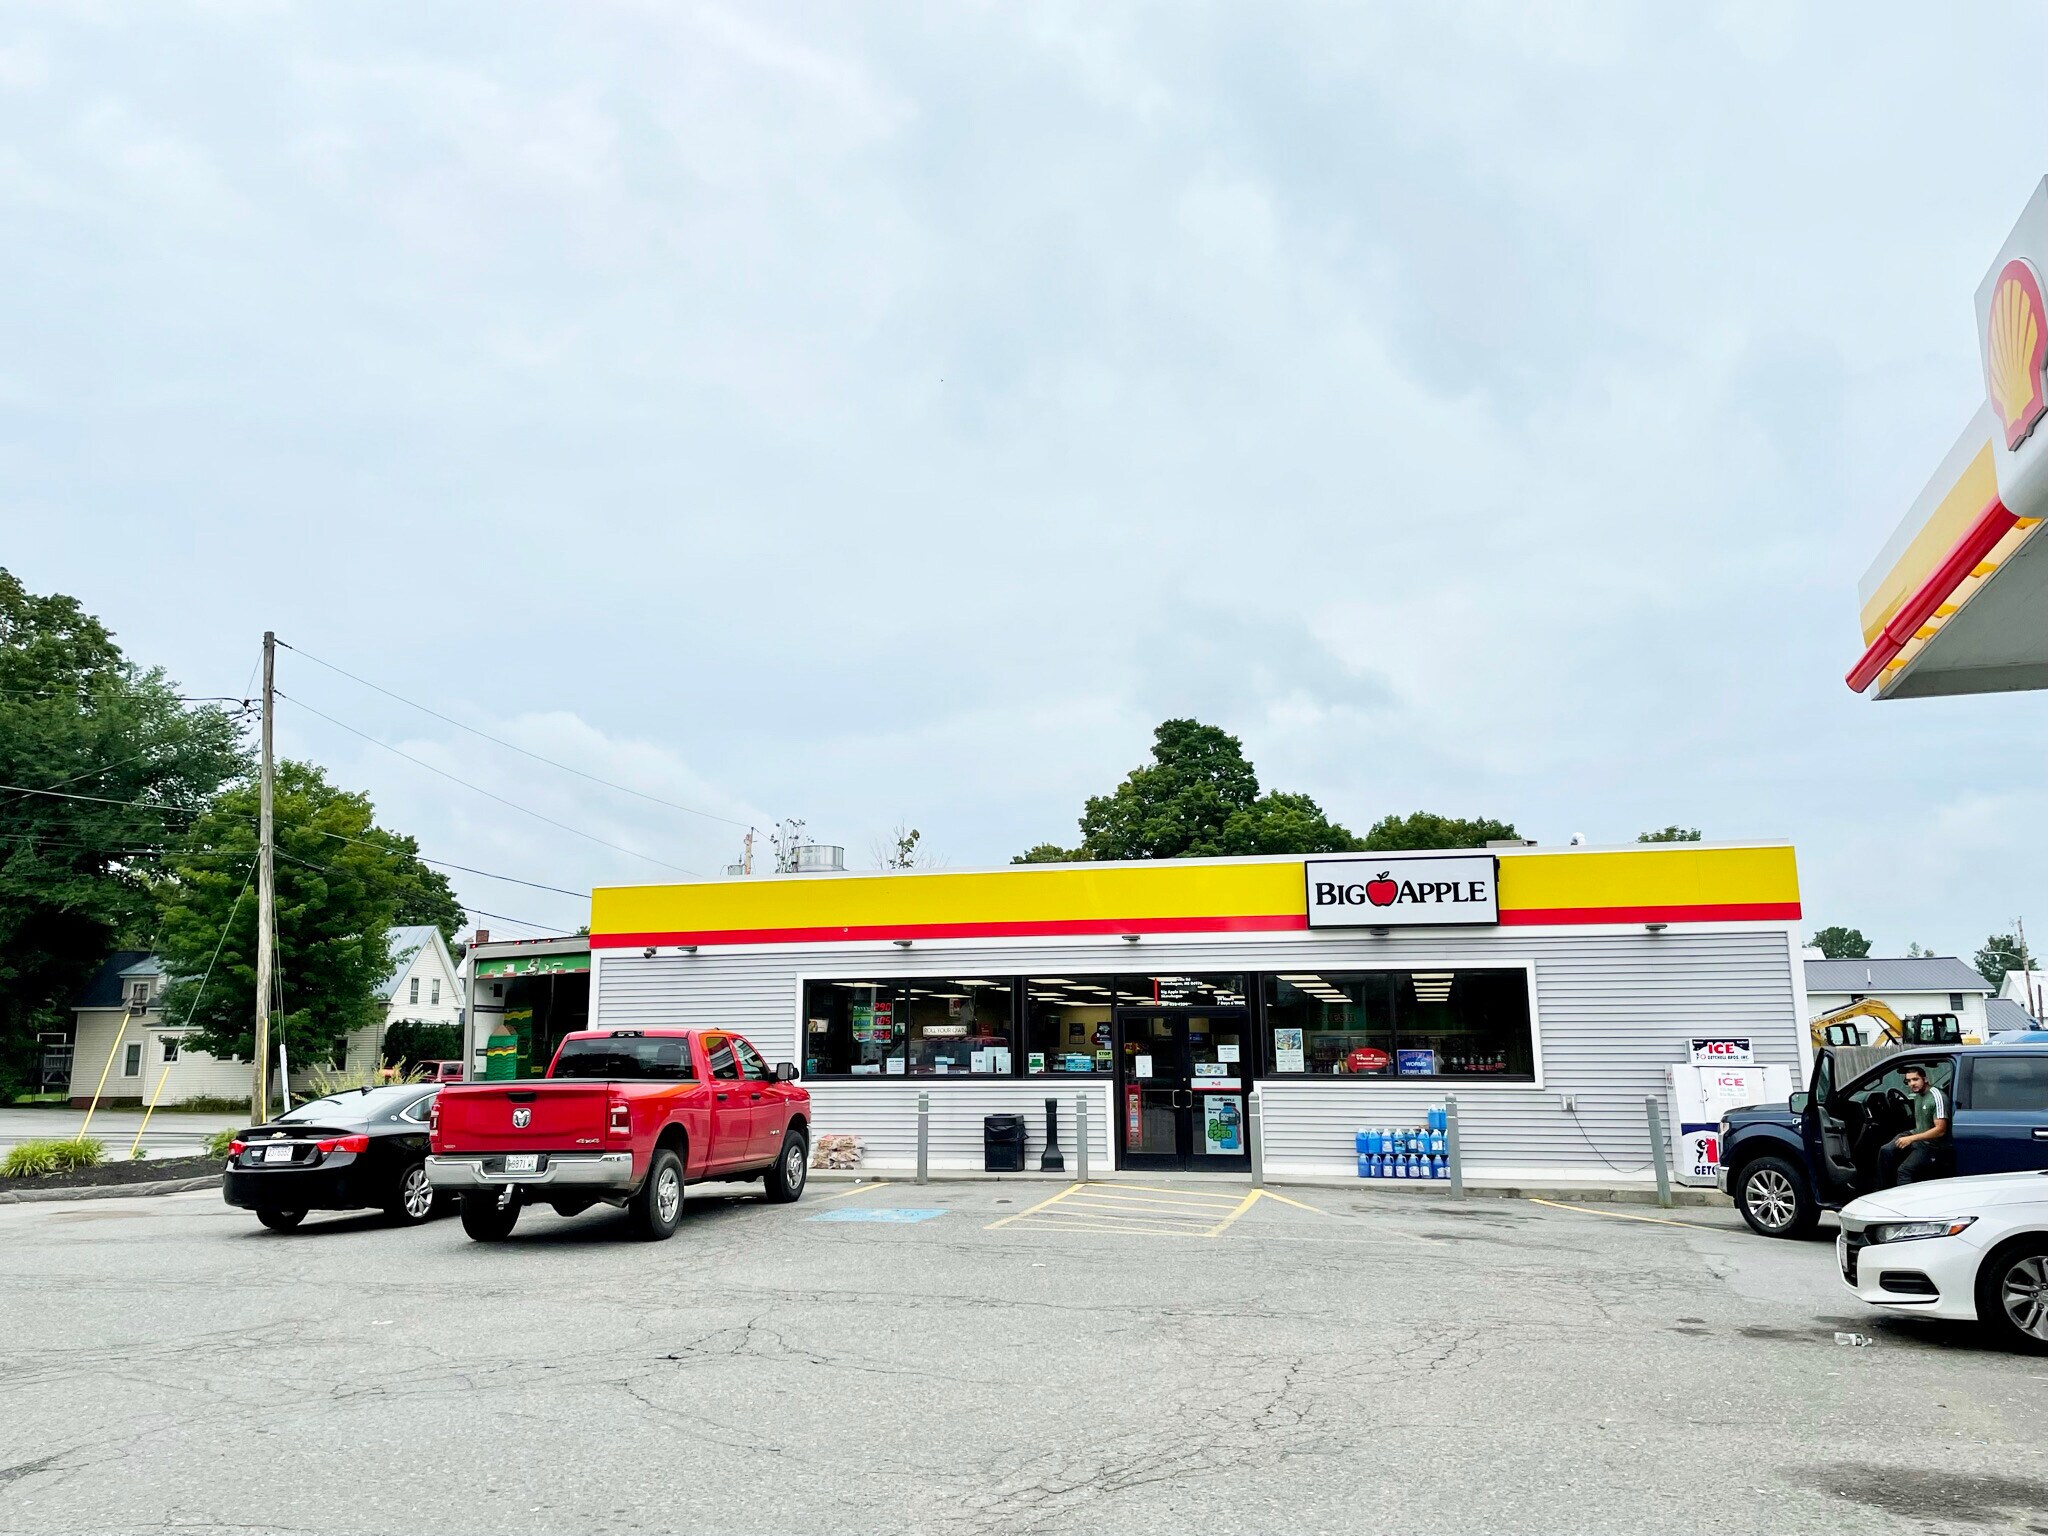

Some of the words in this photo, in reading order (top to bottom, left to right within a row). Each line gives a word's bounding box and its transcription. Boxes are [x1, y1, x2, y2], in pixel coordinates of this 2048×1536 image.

[1315, 882, 1366, 906] BIG
[1397, 880, 1487, 904] APPLE
[873, 1002, 892, 1012] 290
[873, 1030, 891, 1040] 256
[1708, 1043, 1735, 1054] ICE
[1718, 1077, 1744, 1087] ICE
